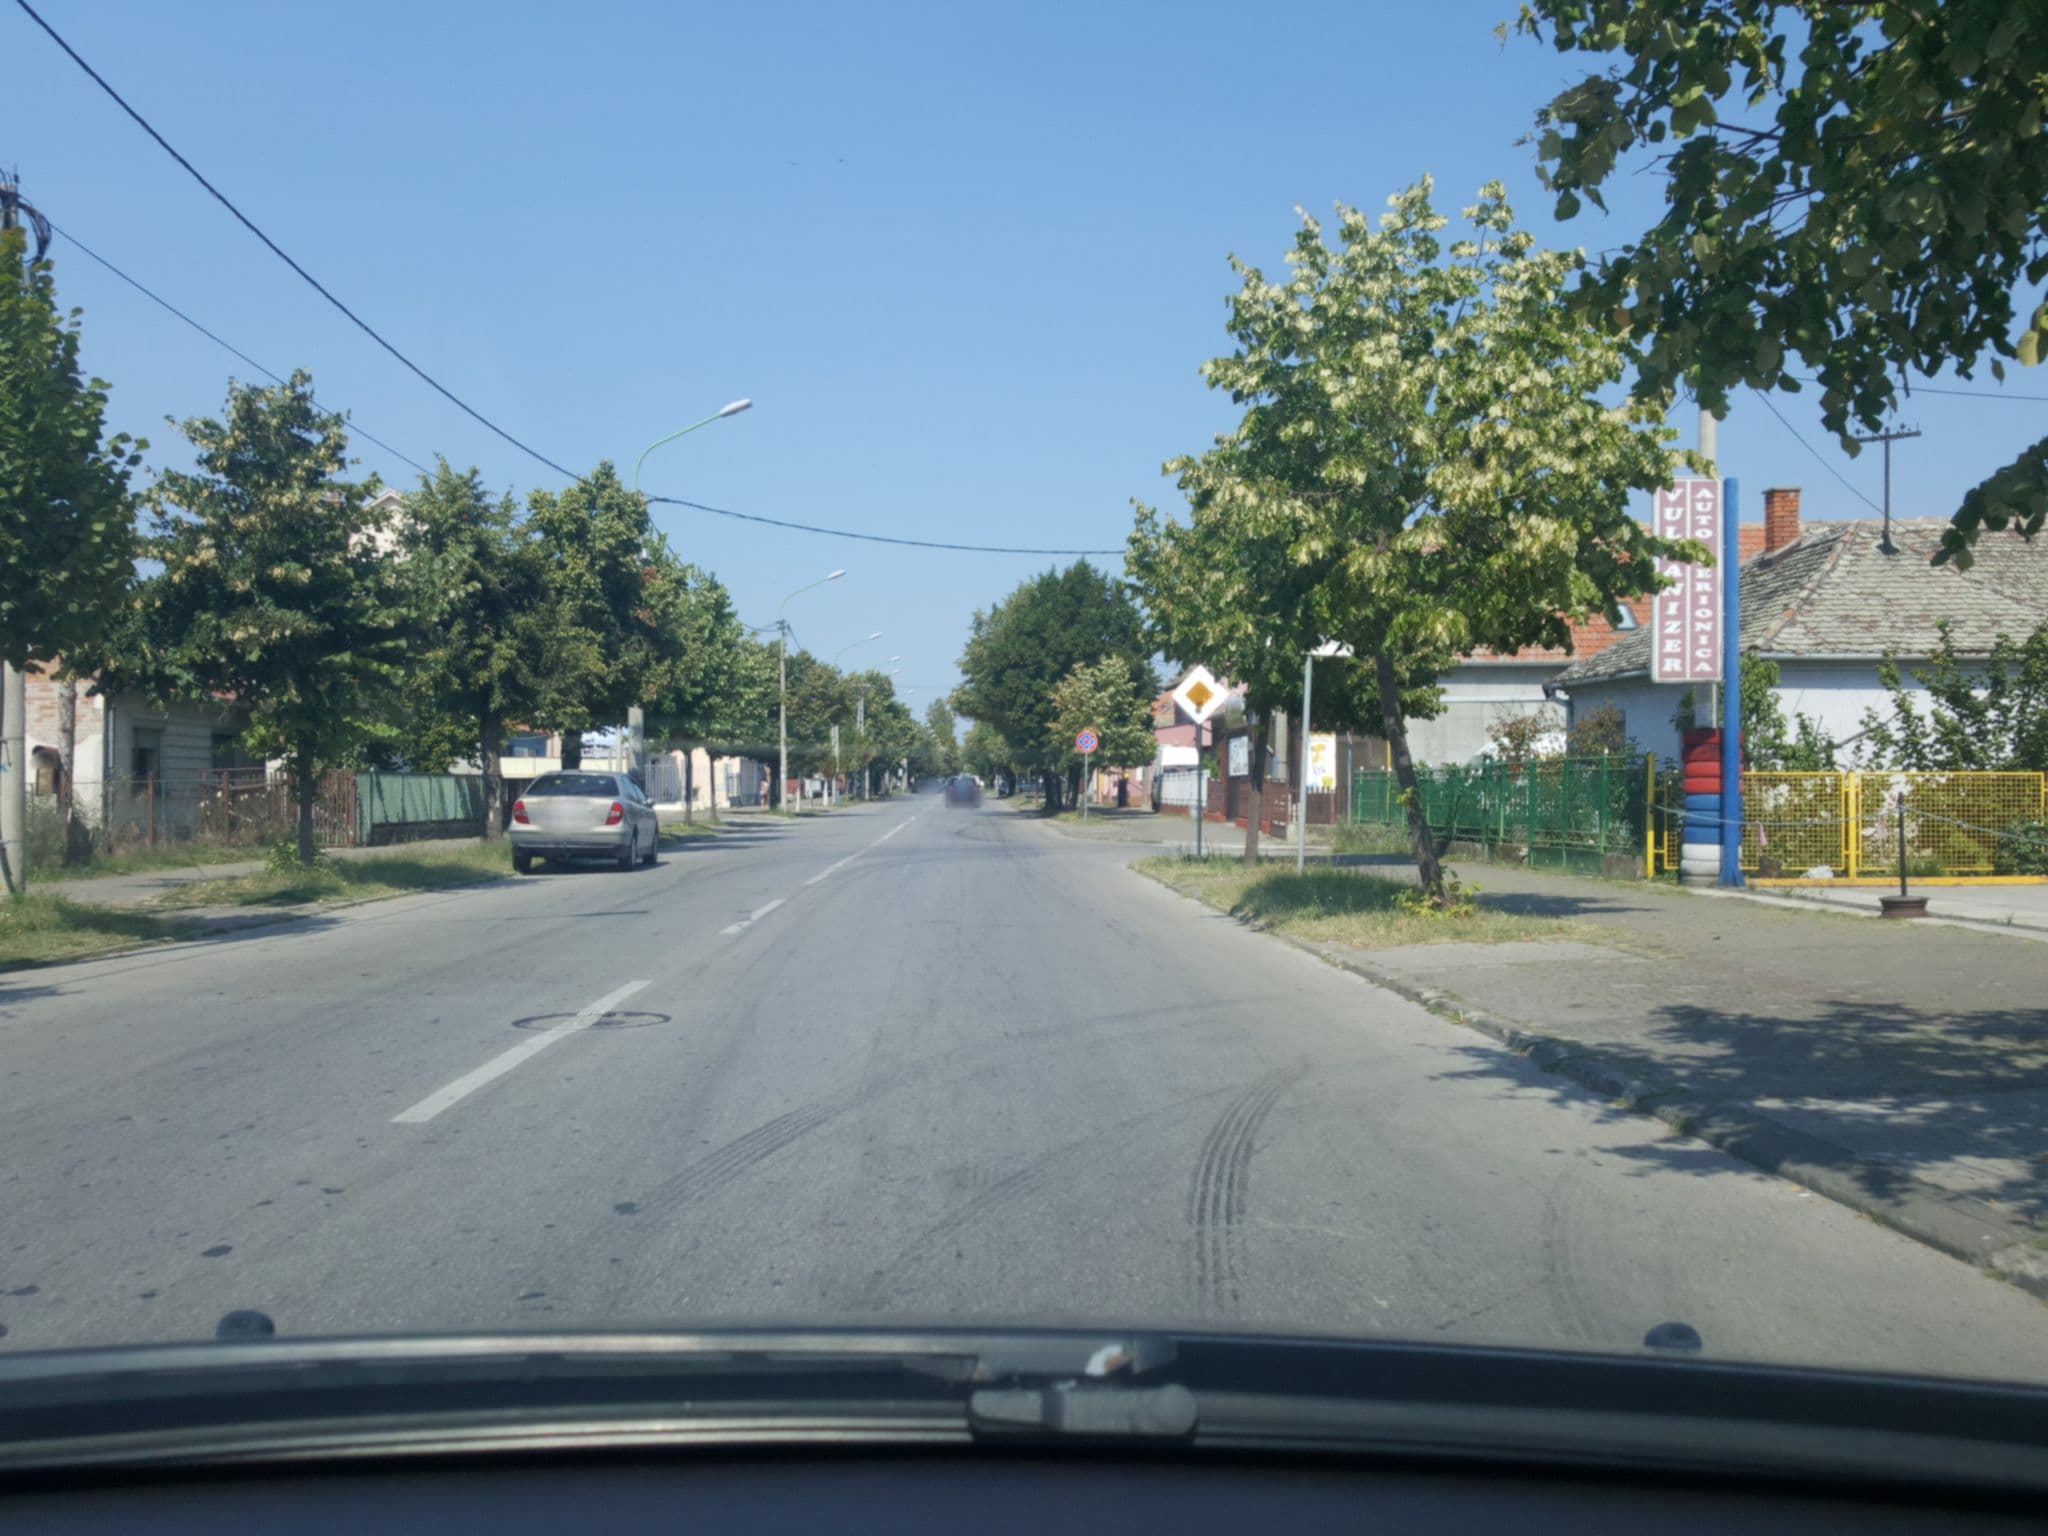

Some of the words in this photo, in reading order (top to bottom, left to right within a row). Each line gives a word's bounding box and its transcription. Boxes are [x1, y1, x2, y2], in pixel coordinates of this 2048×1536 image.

[1694, 488, 1714, 538] AUTO
[1661, 488, 1684, 672] VULANIZER
[1694, 557, 1714, 672] ERIONICA
